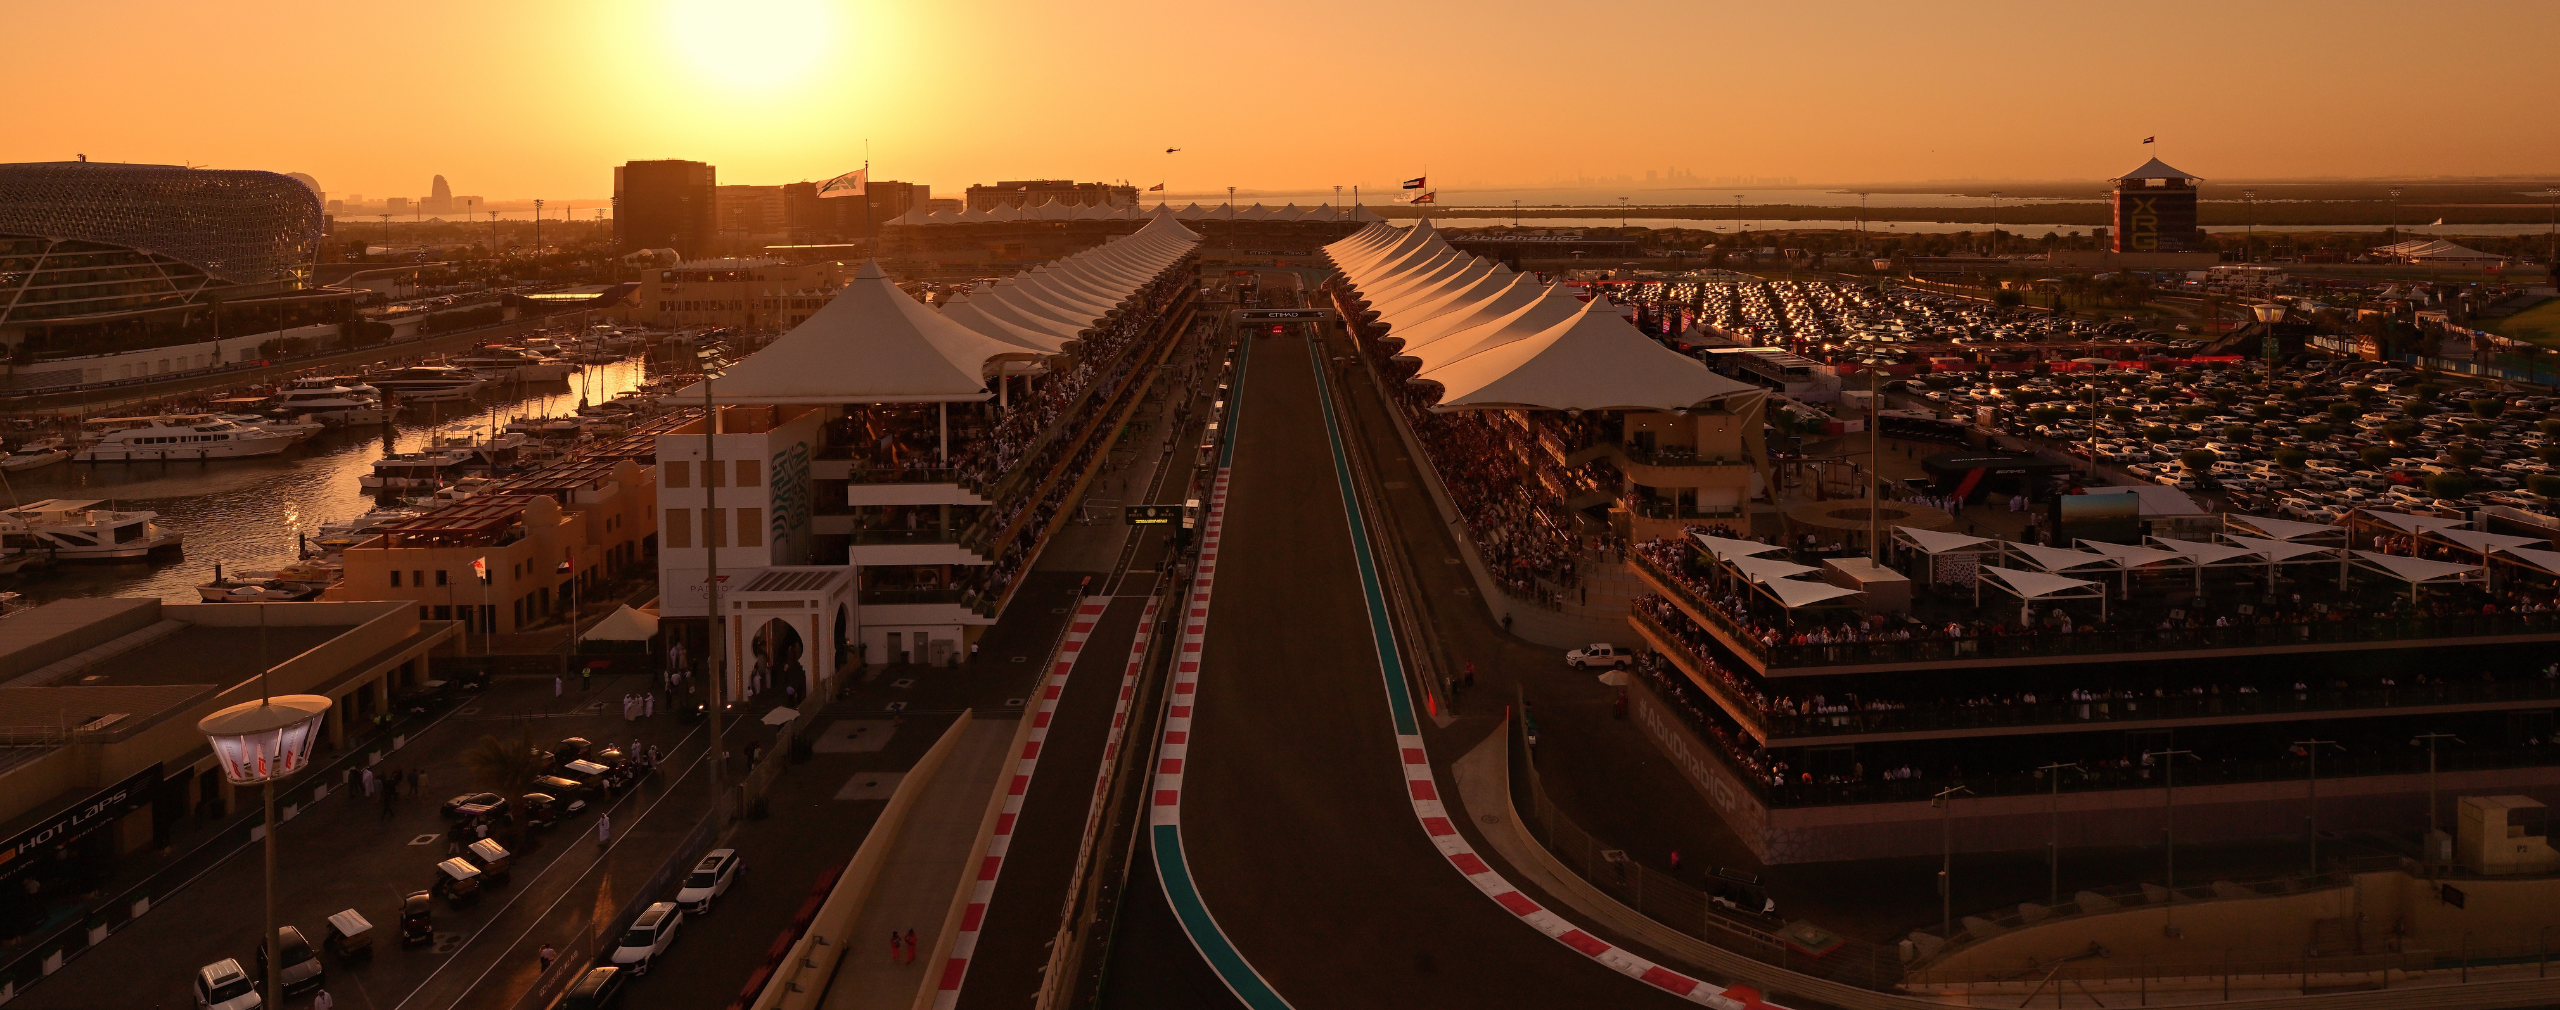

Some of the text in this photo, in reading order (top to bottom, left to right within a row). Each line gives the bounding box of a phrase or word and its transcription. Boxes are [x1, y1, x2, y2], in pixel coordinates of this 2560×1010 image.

[2131, 197, 2158, 249] XRG
[1640, 698, 1737, 813] #AbuDhabiGP
[18, 819, 68, 854] HOT
[2517, 845, 2528, 853] P2
